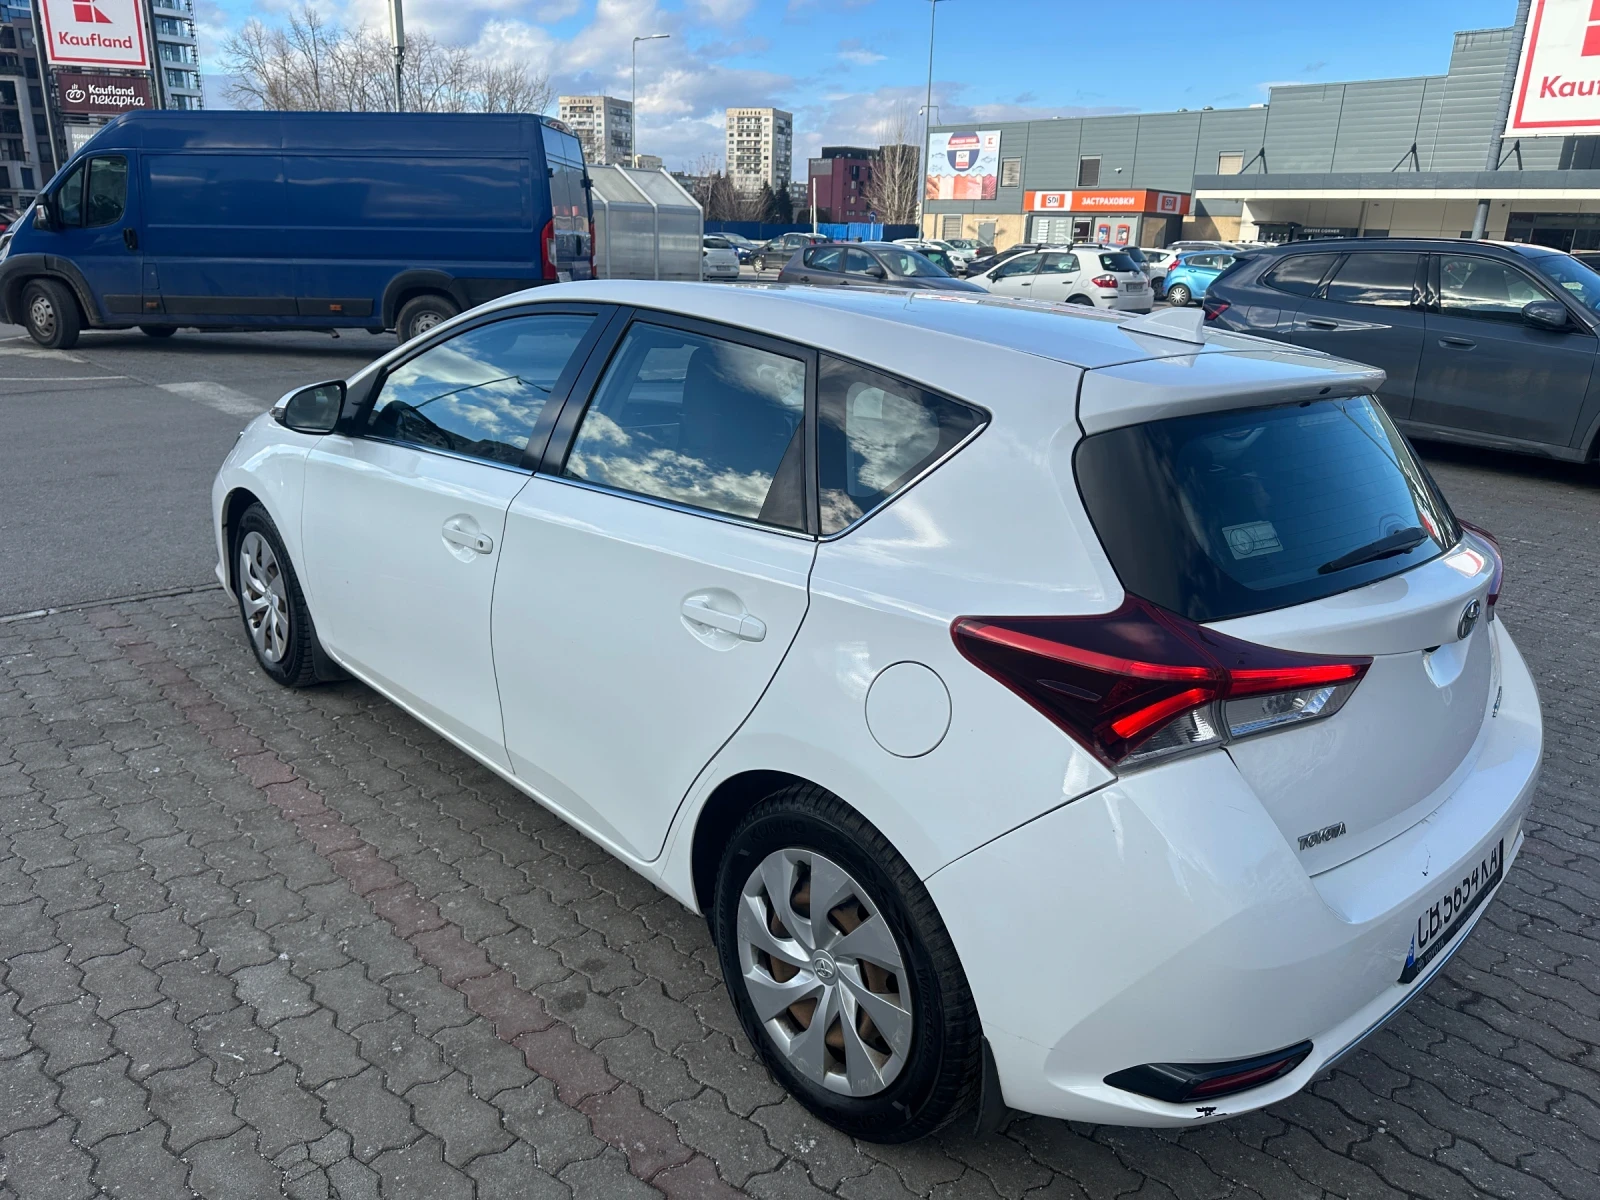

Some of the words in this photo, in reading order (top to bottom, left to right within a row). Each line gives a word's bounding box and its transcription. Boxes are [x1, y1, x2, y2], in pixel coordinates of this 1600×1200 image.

[58, 31, 133, 49] Kaufland
[88, 84, 135, 95] Kaufland
[90, 94, 146, 108] пекарна
[1047, 196, 1059, 204] SDI
[1081, 196, 1136, 206] ЗАСТРАХОВКИ
[1297, 821, 1347, 851] TOYOTA
[1424, 937, 1446, 964] TOYOTA
